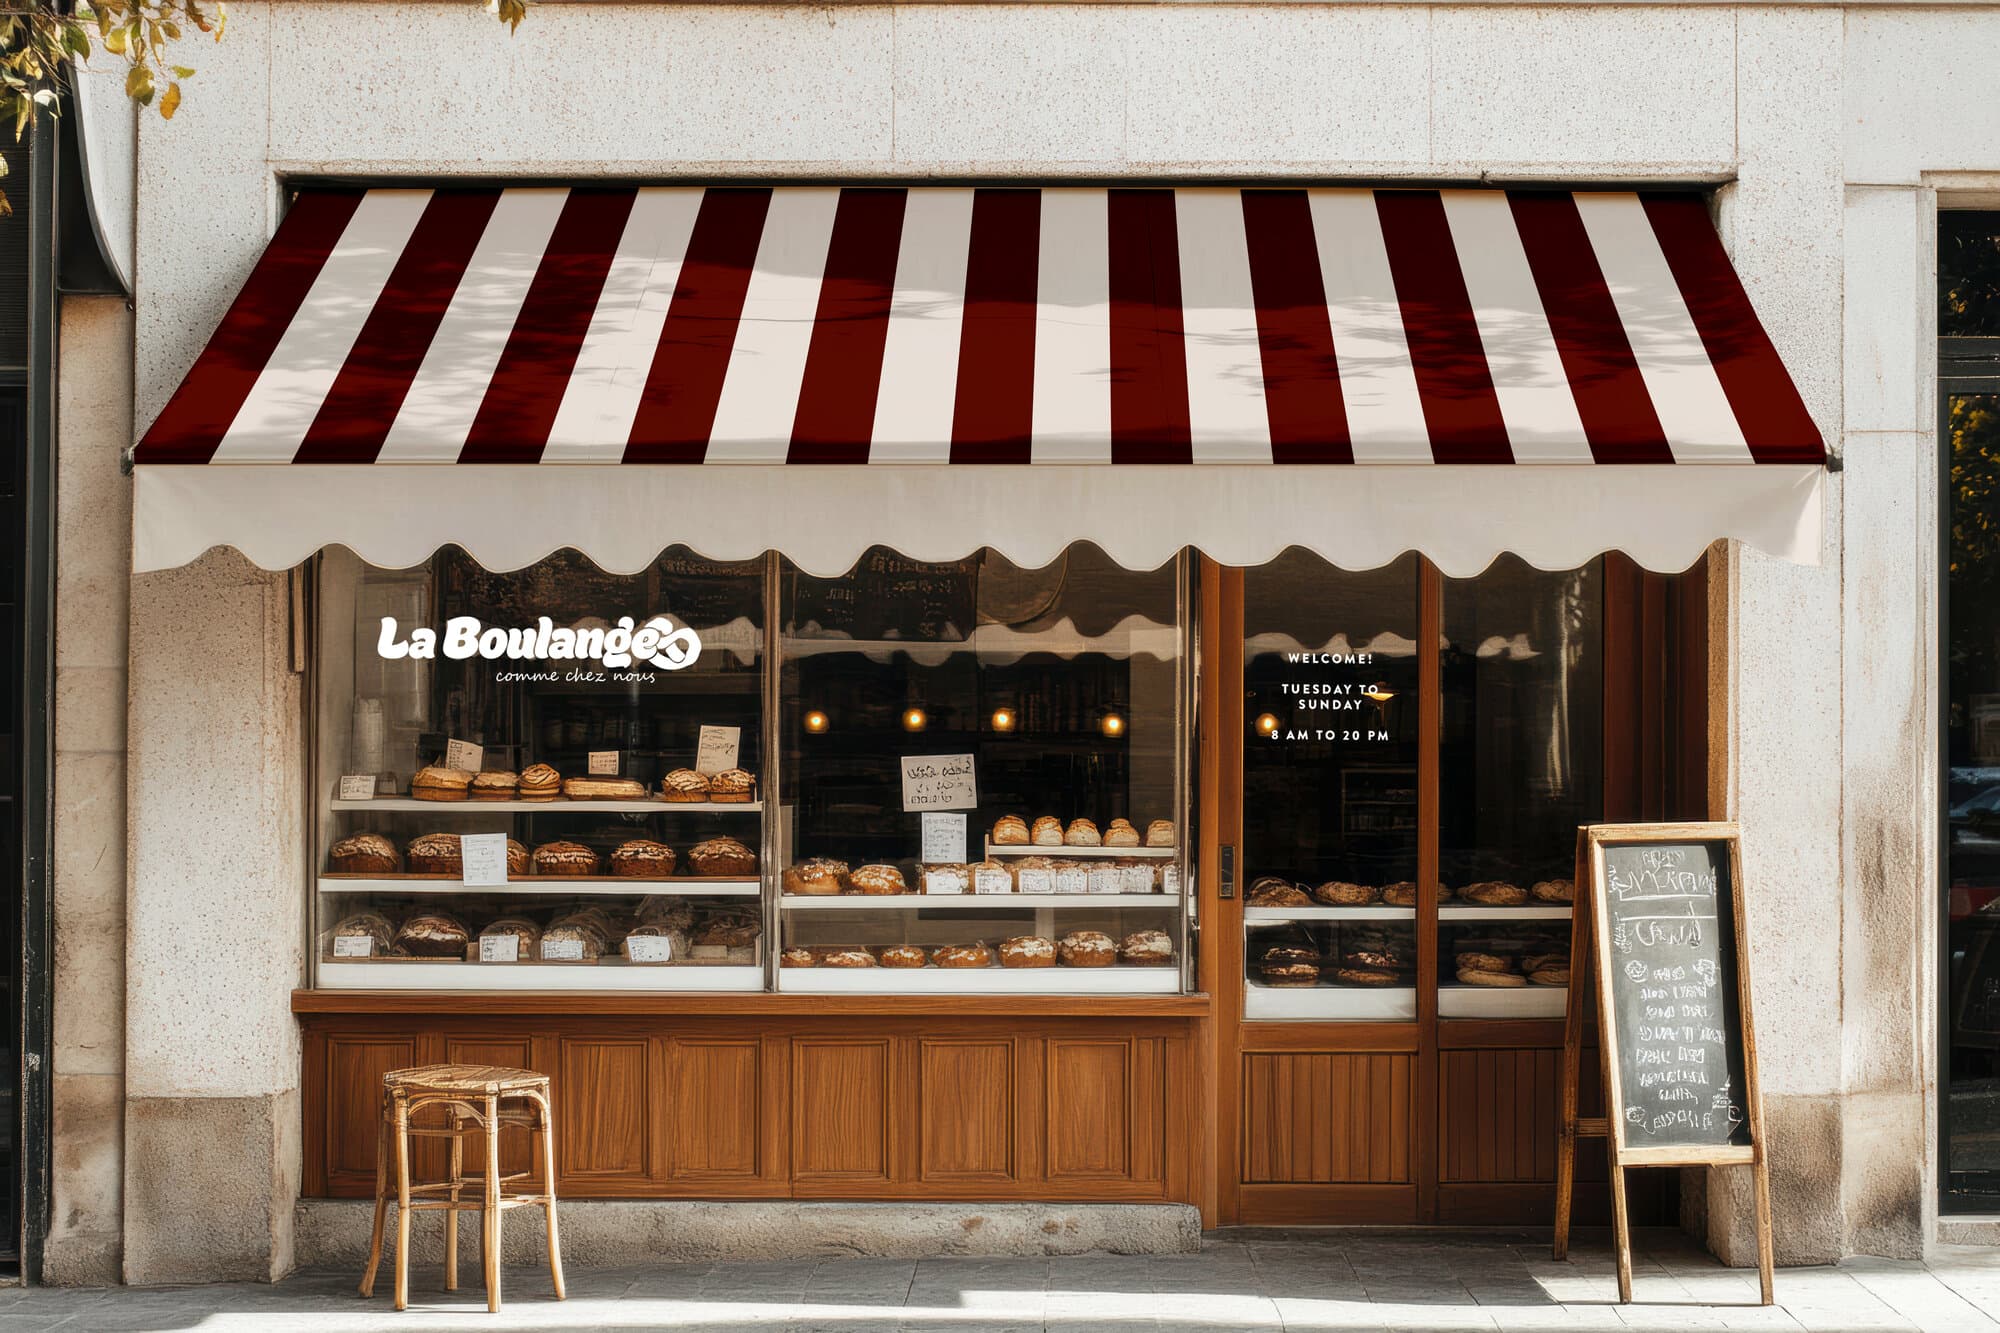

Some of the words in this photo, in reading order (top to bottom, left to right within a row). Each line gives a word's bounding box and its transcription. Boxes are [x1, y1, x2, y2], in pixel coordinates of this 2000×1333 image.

[377, 616, 437, 659] La
[1287, 652, 1373, 665] WELCOME!
[495, 671, 560, 683] comme
[565, 666, 607, 683] chez
[613, 670, 656, 684] nous
[1281, 683, 1352, 695] TUESDAY
[1358, 684, 1379, 695] TO
[1298, 699, 1362, 710] SUNDAY
[1271, 729, 1279, 740] 8
[1286, 730, 1309, 741] AM
[1315, 730, 1336, 741] TO
[1342, 730, 1360, 741] 20
[1367, 731, 1389, 742] PM
